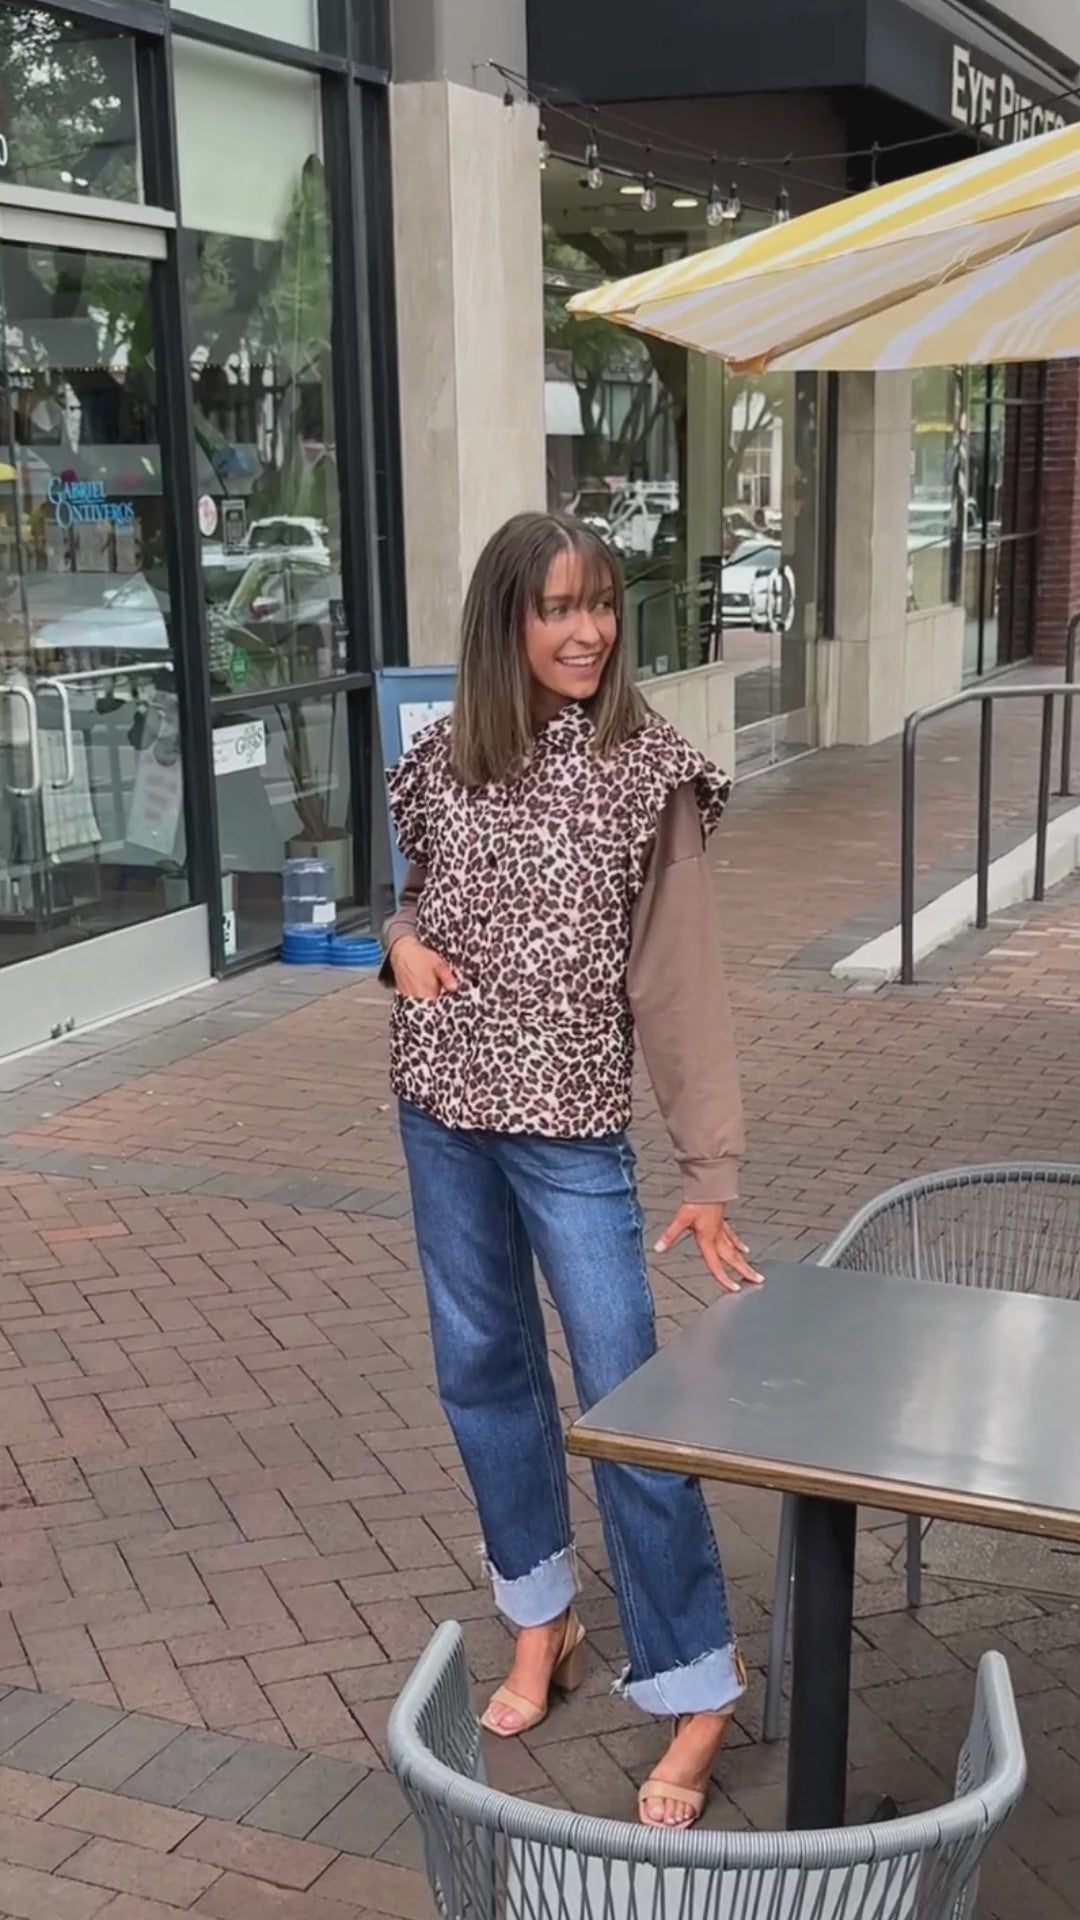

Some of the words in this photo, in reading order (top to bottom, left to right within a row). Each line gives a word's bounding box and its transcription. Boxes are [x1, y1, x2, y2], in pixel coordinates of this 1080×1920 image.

[951, 44, 997, 138] EYE
[998, 73, 1065, 143] PIEC
[47, 476, 107, 504] GABRIEL
